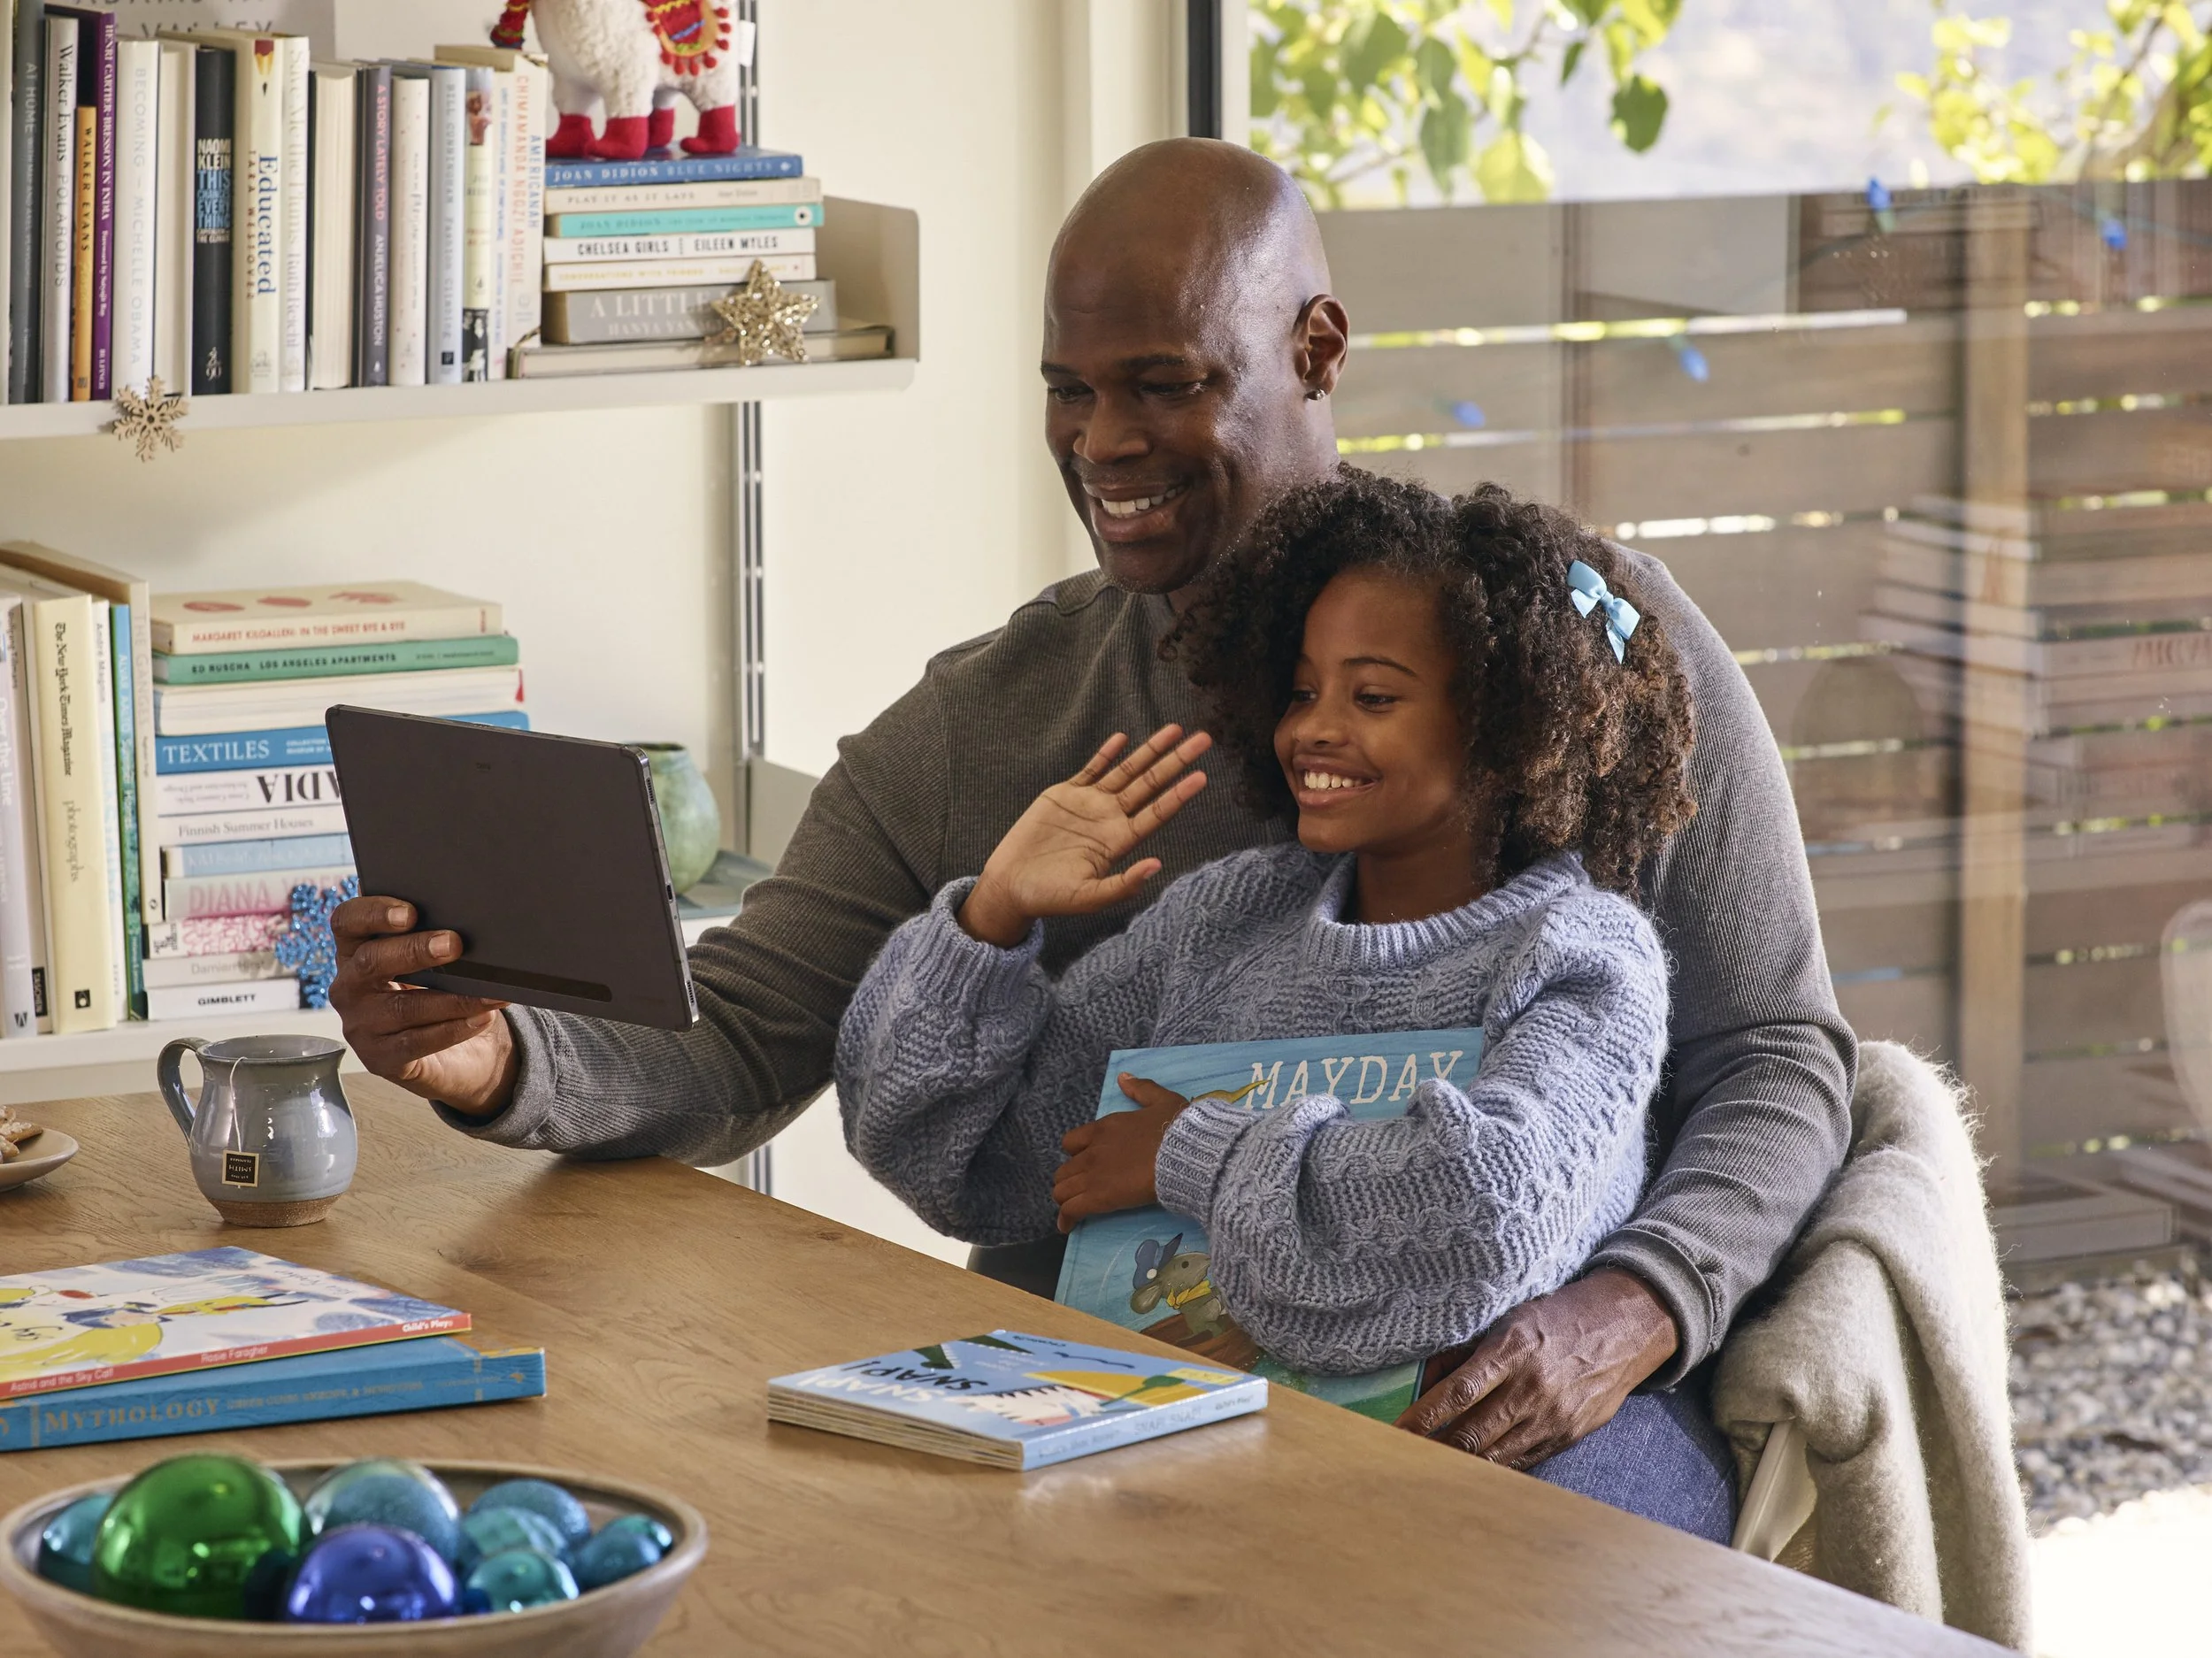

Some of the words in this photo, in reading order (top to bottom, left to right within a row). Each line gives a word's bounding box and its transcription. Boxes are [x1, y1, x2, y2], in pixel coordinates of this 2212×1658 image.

[104, 24, 114, 61] HENRI
[58, 43, 73, 105] Walker
[377, 84, 388, 94] A
[25, 86, 37, 134] HOME
[103, 64, 113, 168] CARTIER-BRESSON
[376, 96, 388, 136] STORY
[445, 83, 456, 116] BILL
[133, 67, 146, 168] BECOMING
[514, 75, 529, 173] CHIMAMANDA
[57, 112, 72, 163] Evans
[197, 138, 231, 154] NAOMI
[82, 127, 93, 192] WALKER
[197, 153, 231, 170] KLEIN
[247, 150, 256, 193] TARA
[375, 139, 387, 185] LATELY
[553, 166, 593, 182] JOAN
[601, 165, 659, 180] DIDION
[666, 164, 705, 178] BLUE
[713, 160, 773, 174] NIGHTS
[102, 171, 112, 184] IN
[196, 169, 231, 189] THIS
[527, 134, 541, 228] AMERICANAH
[101, 188, 111, 220] INDIA
[374, 187, 386, 221] TOLD
[512, 180, 527, 223] NGOZI
[567, 194, 597, 204] PLAY
[603, 194, 617, 203] IT
[664, 190, 695, 201] LAYS
[55, 174, 69, 288] POLAROIDS
[81, 202, 90, 251] EVANS
[132, 196, 145, 285] MICHELLE
[257, 155, 280, 295] Educated
[580, 218, 611, 231] JOAN
[616, 217, 663, 228] DIDION
[245, 207, 255, 300] WESTOVER
[578, 242, 628, 257] CHELSEA
[635, 240, 669, 254] GIRLS
[694, 237, 735, 252] EILEEN
[741, 235, 779, 249] MYLES
[286, 252, 301, 293] Ruth
[373, 234, 385, 294] ANJELICA
[590, 296, 607, 319] A
[616, 288, 711, 317] LITTLE
[130, 296, 143, 365] OBAMA
[373, 295, 384, 347] HUSTON
[608, 321, 662, 337] HANYA
[55, 622, 66, 641] The
[134, 614, 148, 647] THE
[192, 631, 242, 643] MARGARET
[300, 626, 311, 636] IN
[312, 625, 329, 636] THE
[332, 623, 360, 636] SWEET
[57, 643, 68, 666] New
[191, 664, 205, 675] ED
[208, 661, 250, 674] RUSCHA
[259, 659, 279, 671] LOS
[281, 656, 327, 669] ANGELES
[331, 652, 397, 667] APARTMENTS
[55, 668, 69, 693] York
[135, 655, 150, 726] GANGES
[59, 694, 71, 725] Times
[1, 739, 12, 764] the
[59, 726, 73, 777] Magazine
[162, 740, 271, 765] TEXTILES
[2, 771, 14, 807] Line
[63, 800, 85, 882] photographs
[178, 817, 223, 838] Finnish
[223, 815, 273, 833] Summer
[273, 813, 314, 830] Houses
[188, 879, 272, 915] DIANA
[191, 960, 238, 975] Damien
[197, 994, 257, 1007] GIMBLETT
[1243, 1049, 1464, 1110] MAYDAY
[228, 1163, 252, 1172] SMITH
[402, 1320, 430, 1333] Child's
[200, 1351, 227, 1364] Rosie
[39, 1377, 57, 1389] and
[58, 1374, 73, 1386] the
[74, 1371, 93, 1386] Sky
[796, 1373, 947, 1403] SNAP!
[840, 1360, 989, 1391] SNAP!
[45, 1397, 220, 1433] MYTHOLOGY
